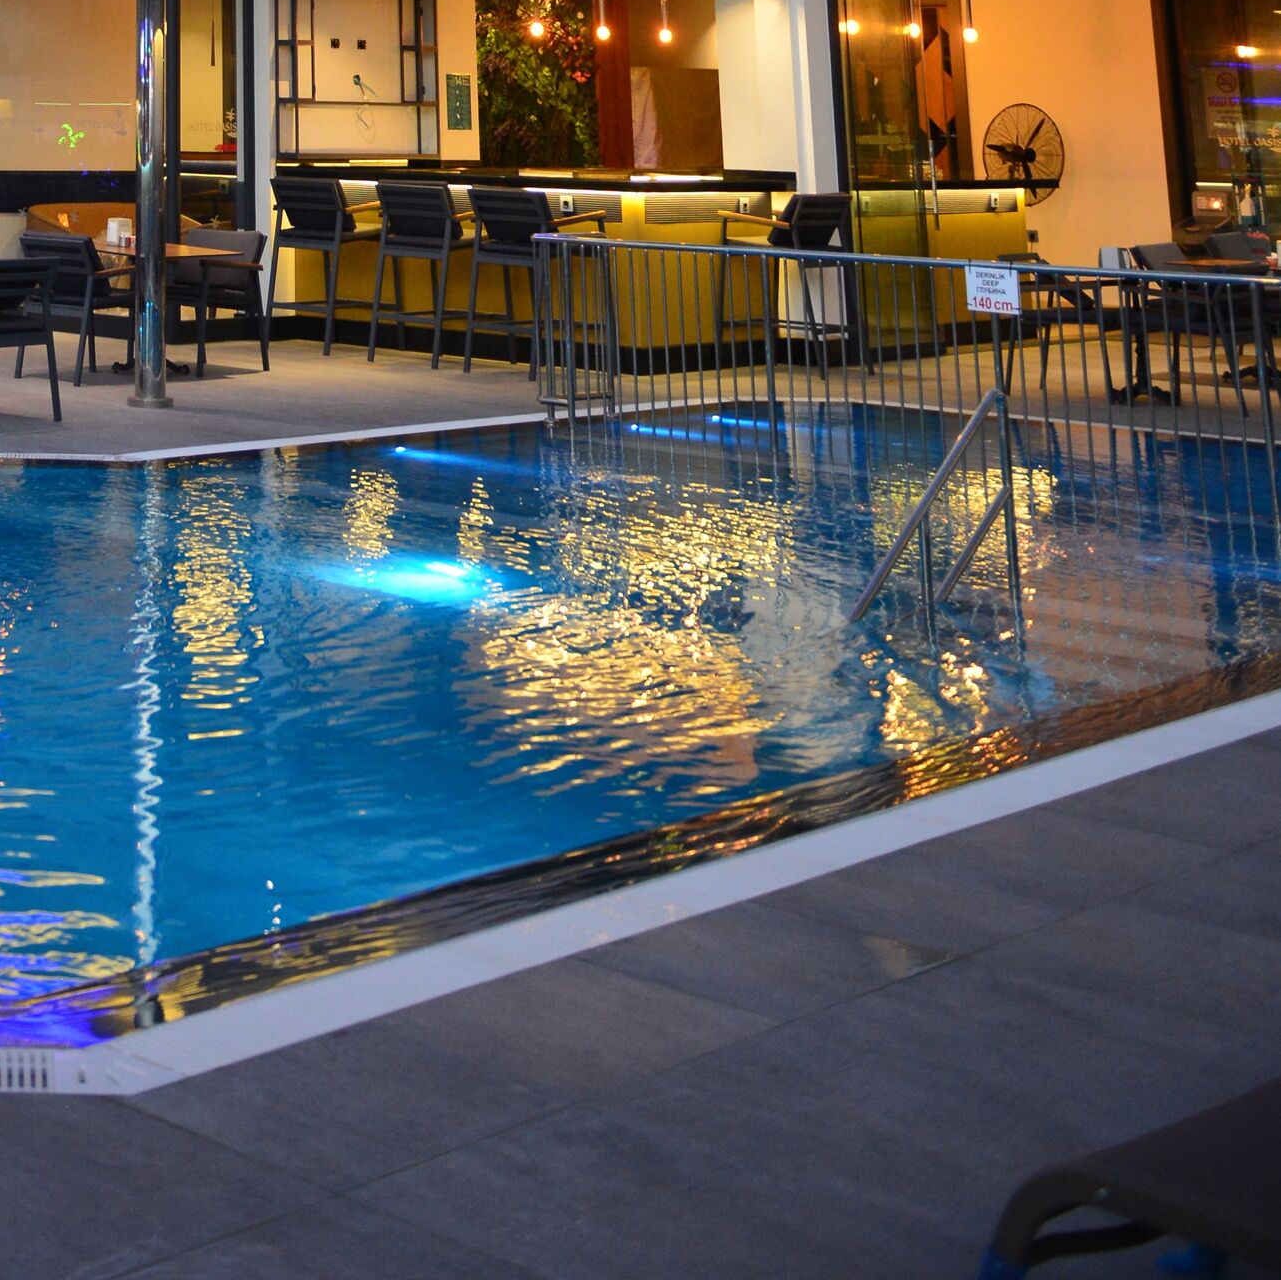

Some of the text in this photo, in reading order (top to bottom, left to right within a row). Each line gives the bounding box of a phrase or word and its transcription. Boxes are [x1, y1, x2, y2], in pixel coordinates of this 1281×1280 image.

[982, 280, 1000, 288] DEEP
[976, 286, 1007, 296] ГЛУБИНА
[972, 296, 1013, 312] 140 cm
